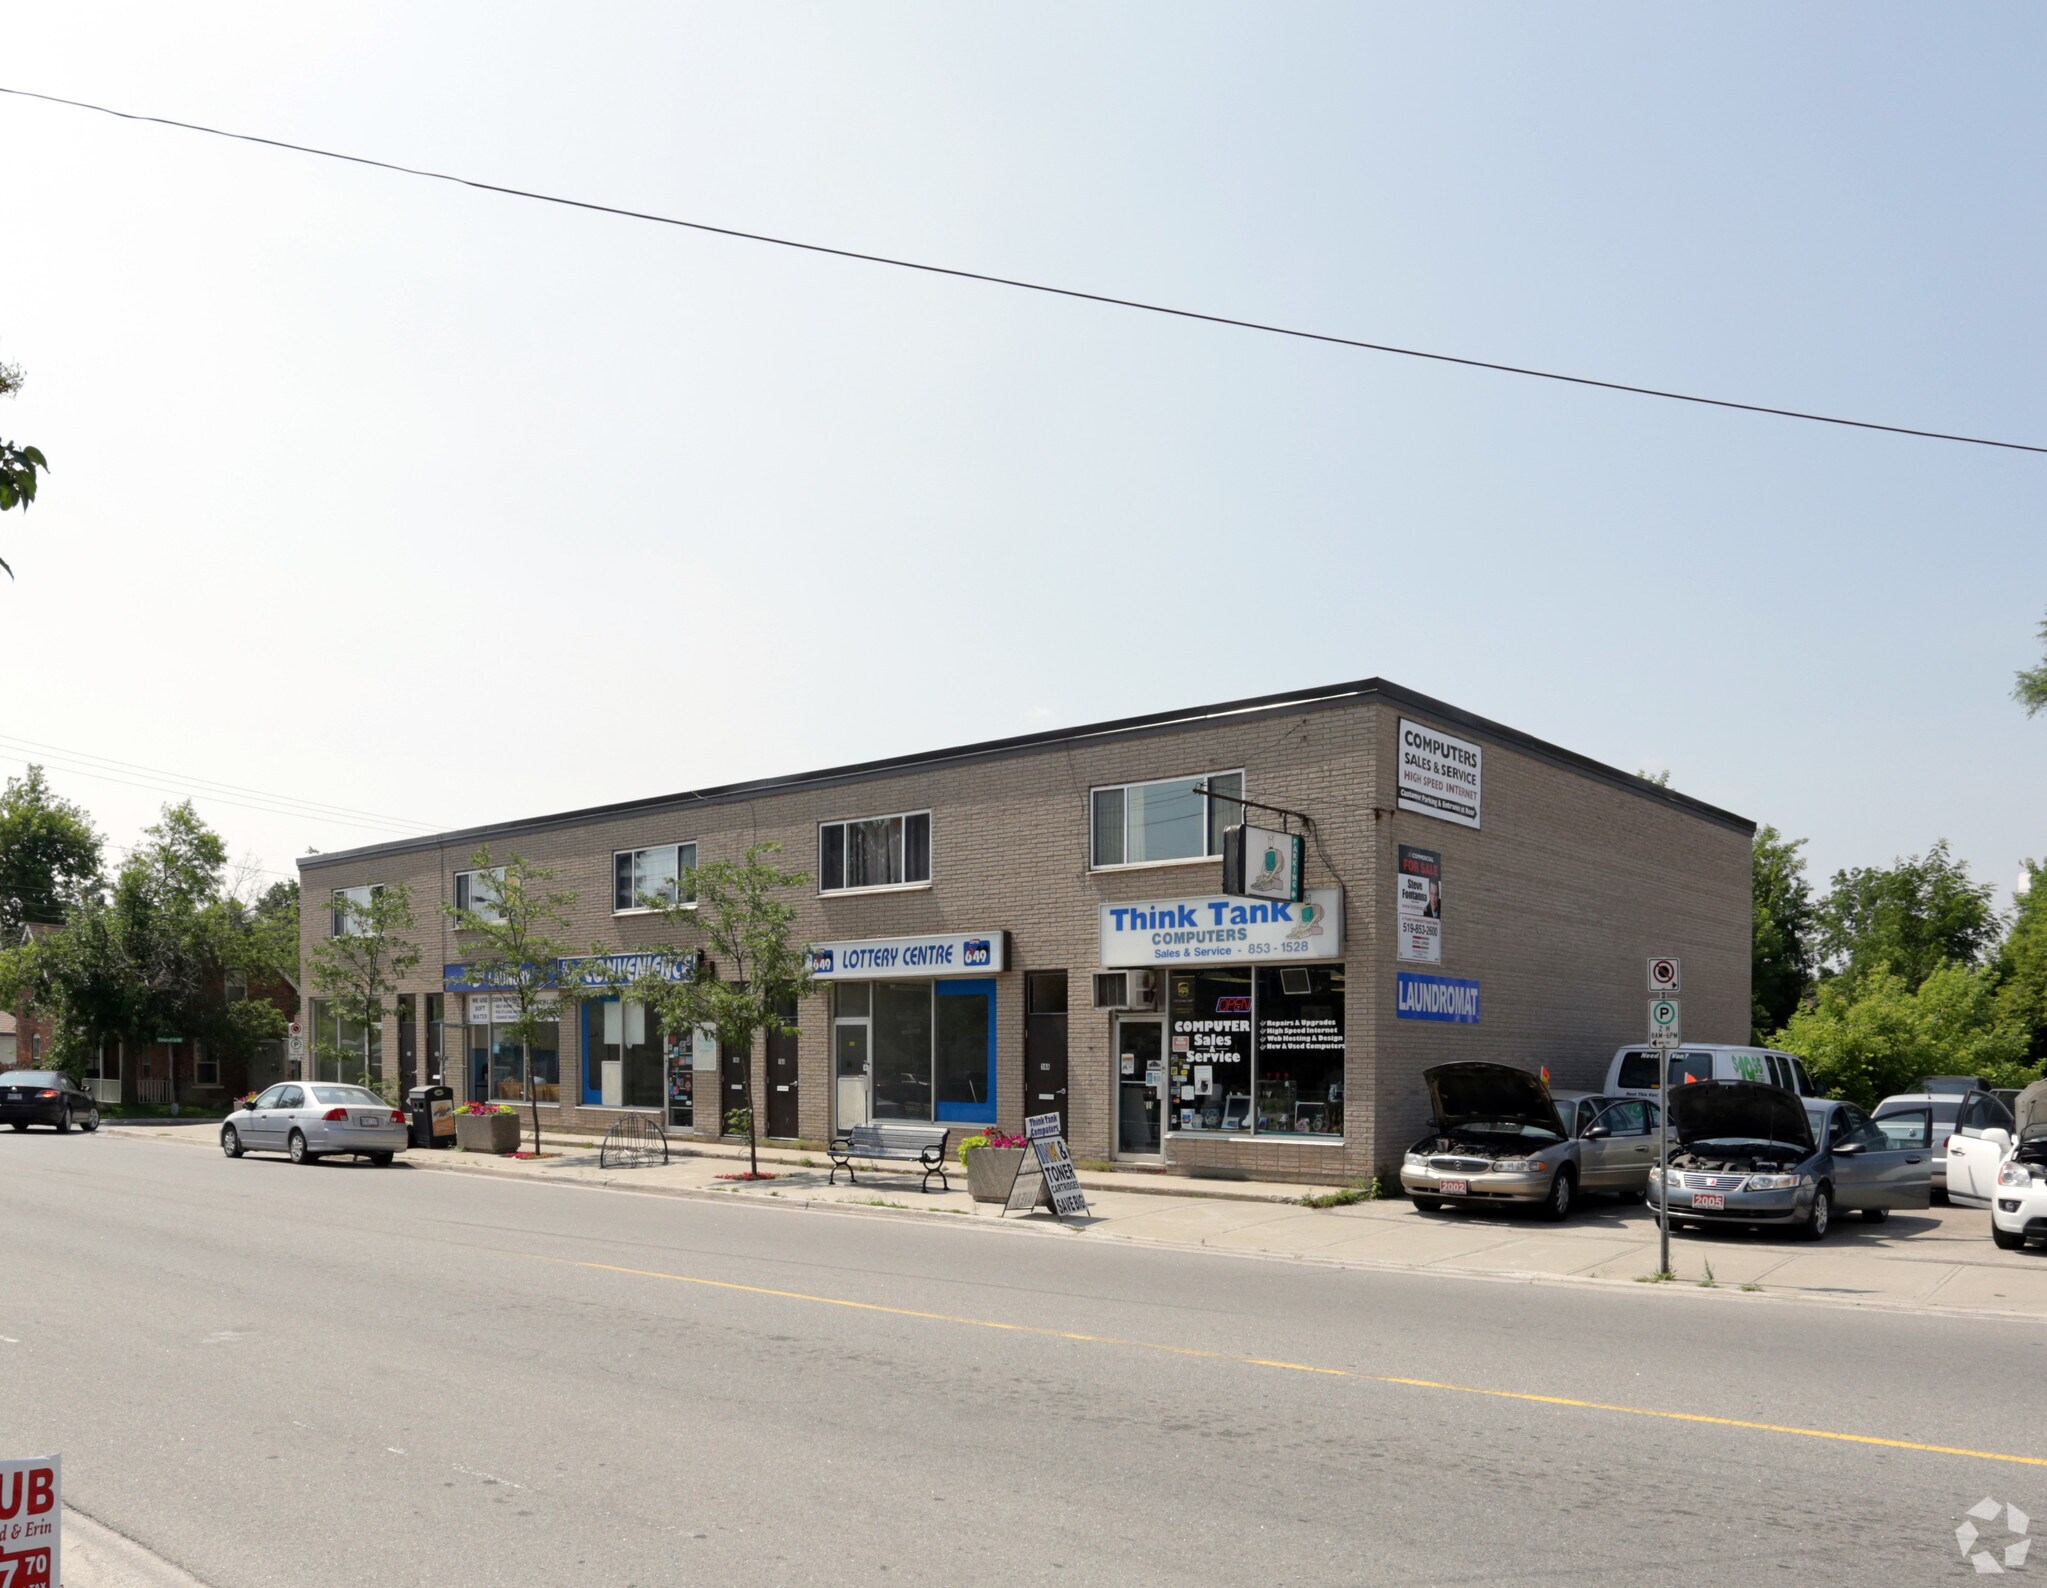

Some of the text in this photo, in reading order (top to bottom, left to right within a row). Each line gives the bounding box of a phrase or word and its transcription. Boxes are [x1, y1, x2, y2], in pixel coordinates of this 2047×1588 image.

[1404, 730, 1477, 768] COMPUTERS
[1404, 752, 1476, 786] SALES & SERVICE
[1404, 770, 1477, 801] HIGH SPEED INTERNET
[1403, 858, 1439, 878] FOR SALE
[1407, 878, 1423, 891] Steve
[1110, 901, 1293, 931] Think Tank
[1152, 927, 1247, 945] COMPUTERS
[842, 944, 953, 969] LOTTERY CENTRE
[1154, 948, 1181, 959] Sales
[1184, 948, 1191, 957] &
[1194, 946, 1231, 957] Service
[1219, 998, 1252, 1011] OPEN
[1398, 980, 1478, 1015] LAUNDROMAT
[1660, 1007, 1669, 1019] P
[1174, 1020, 1250, 1032] COMPUTER
[1301, 1019, 1336, 1027] Upgrades
[1194, 1034, 1232, 1046] Sales
[1186, 1050, 1240, 1062] Service
[1209, 1045, 1216, 1053] &
[1029, 1113, 1058, 1127] Think Tank
[1030, 1124, 1060, 1137] Computers
[1057, 1140, 1068, 1160] &
[1045, 1163, 1076, 1183] TONER
[1051, 1180, 1080, 1194] CARTRIDGES
[1442, 1182, 1465, 1191] 2002
[1056, 1196, 1076, 1214] SAVE
[1695, 1196, 1722, 1207] 2005
[0, 1468, 55, 1520] UB
[11, 1523, 22, 1540] &
[25, 1518, 52, 1538] Erin
[25, 1554, 47, 1576] 70
